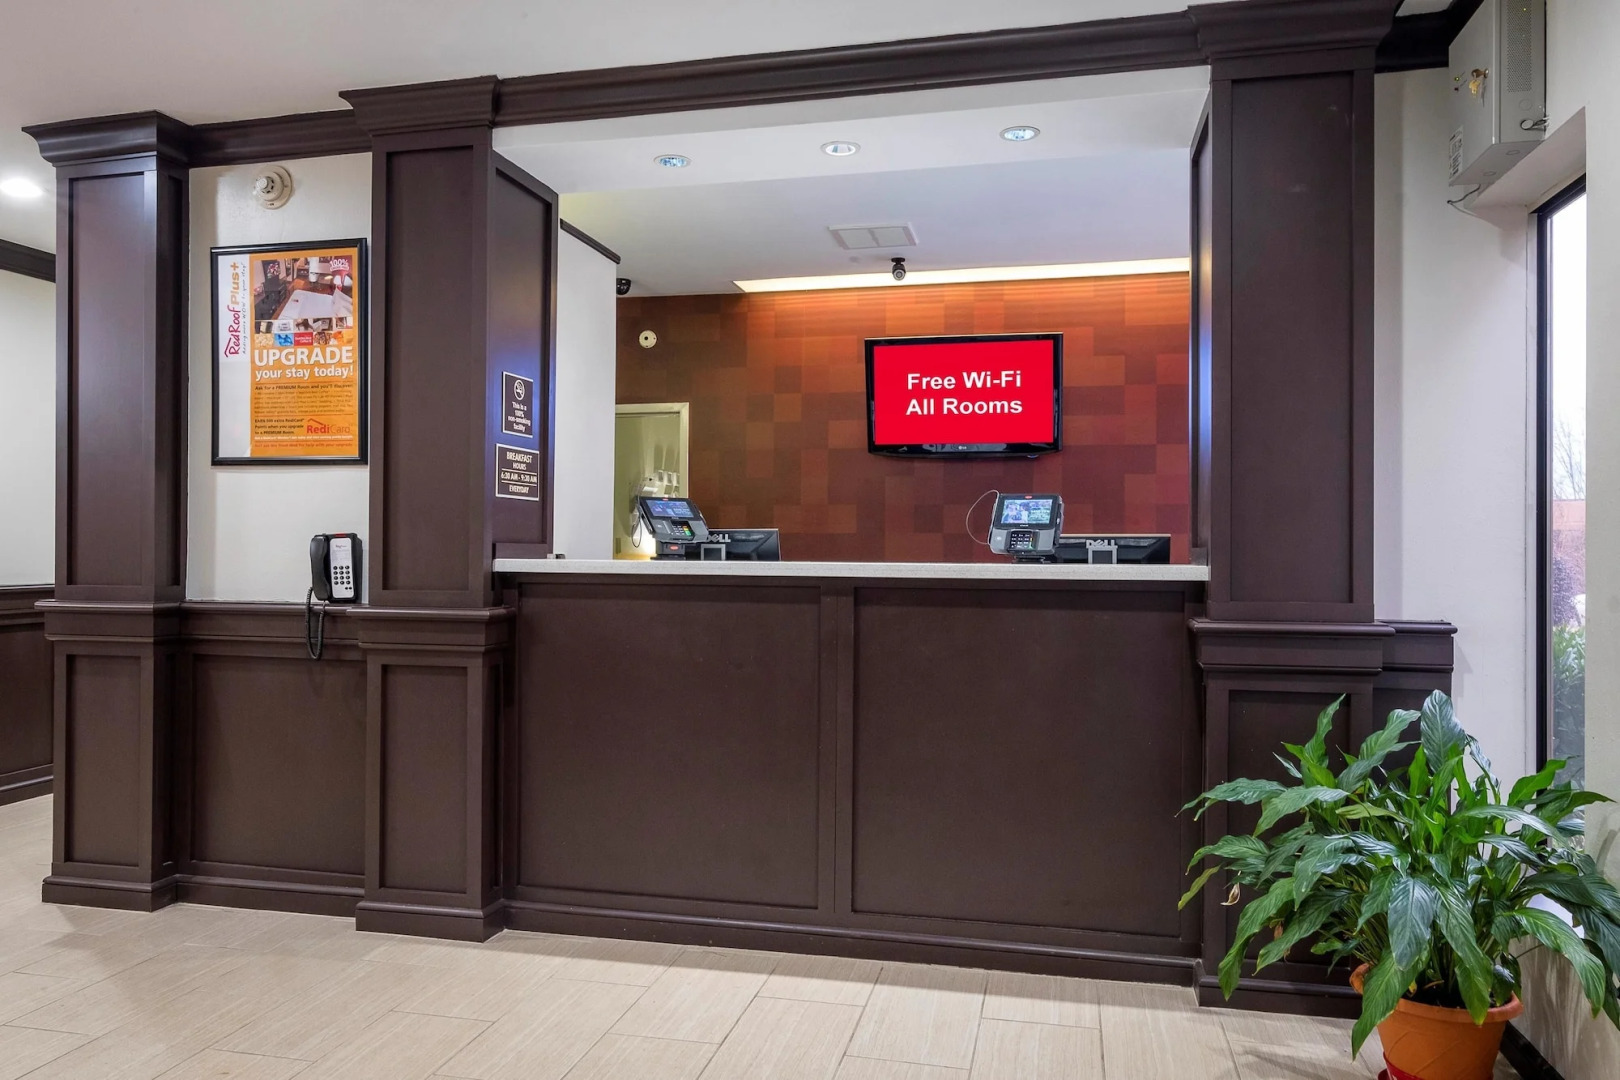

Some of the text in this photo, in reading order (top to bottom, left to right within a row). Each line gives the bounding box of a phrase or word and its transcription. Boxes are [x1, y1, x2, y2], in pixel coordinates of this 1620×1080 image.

[330, 259, 349, 267] 100%
[254, 346, 353, 366] UPGRADE
[256, 365, 353, 382] your stay today!
[907, 370, 1021, 390] Free Wi-Fi
[906, 398, 1023, 415] All Rooms
[508, 416, 531, 426] non-smoking
[513, 423, 525, 432] facility
[506, 451, 532, 463] BREAKFAST
[501, 472, 510, 480] 6:30
[509, 485, 529, 493] EVERYDAY
[1086, 539, 1118, 548] DELL
